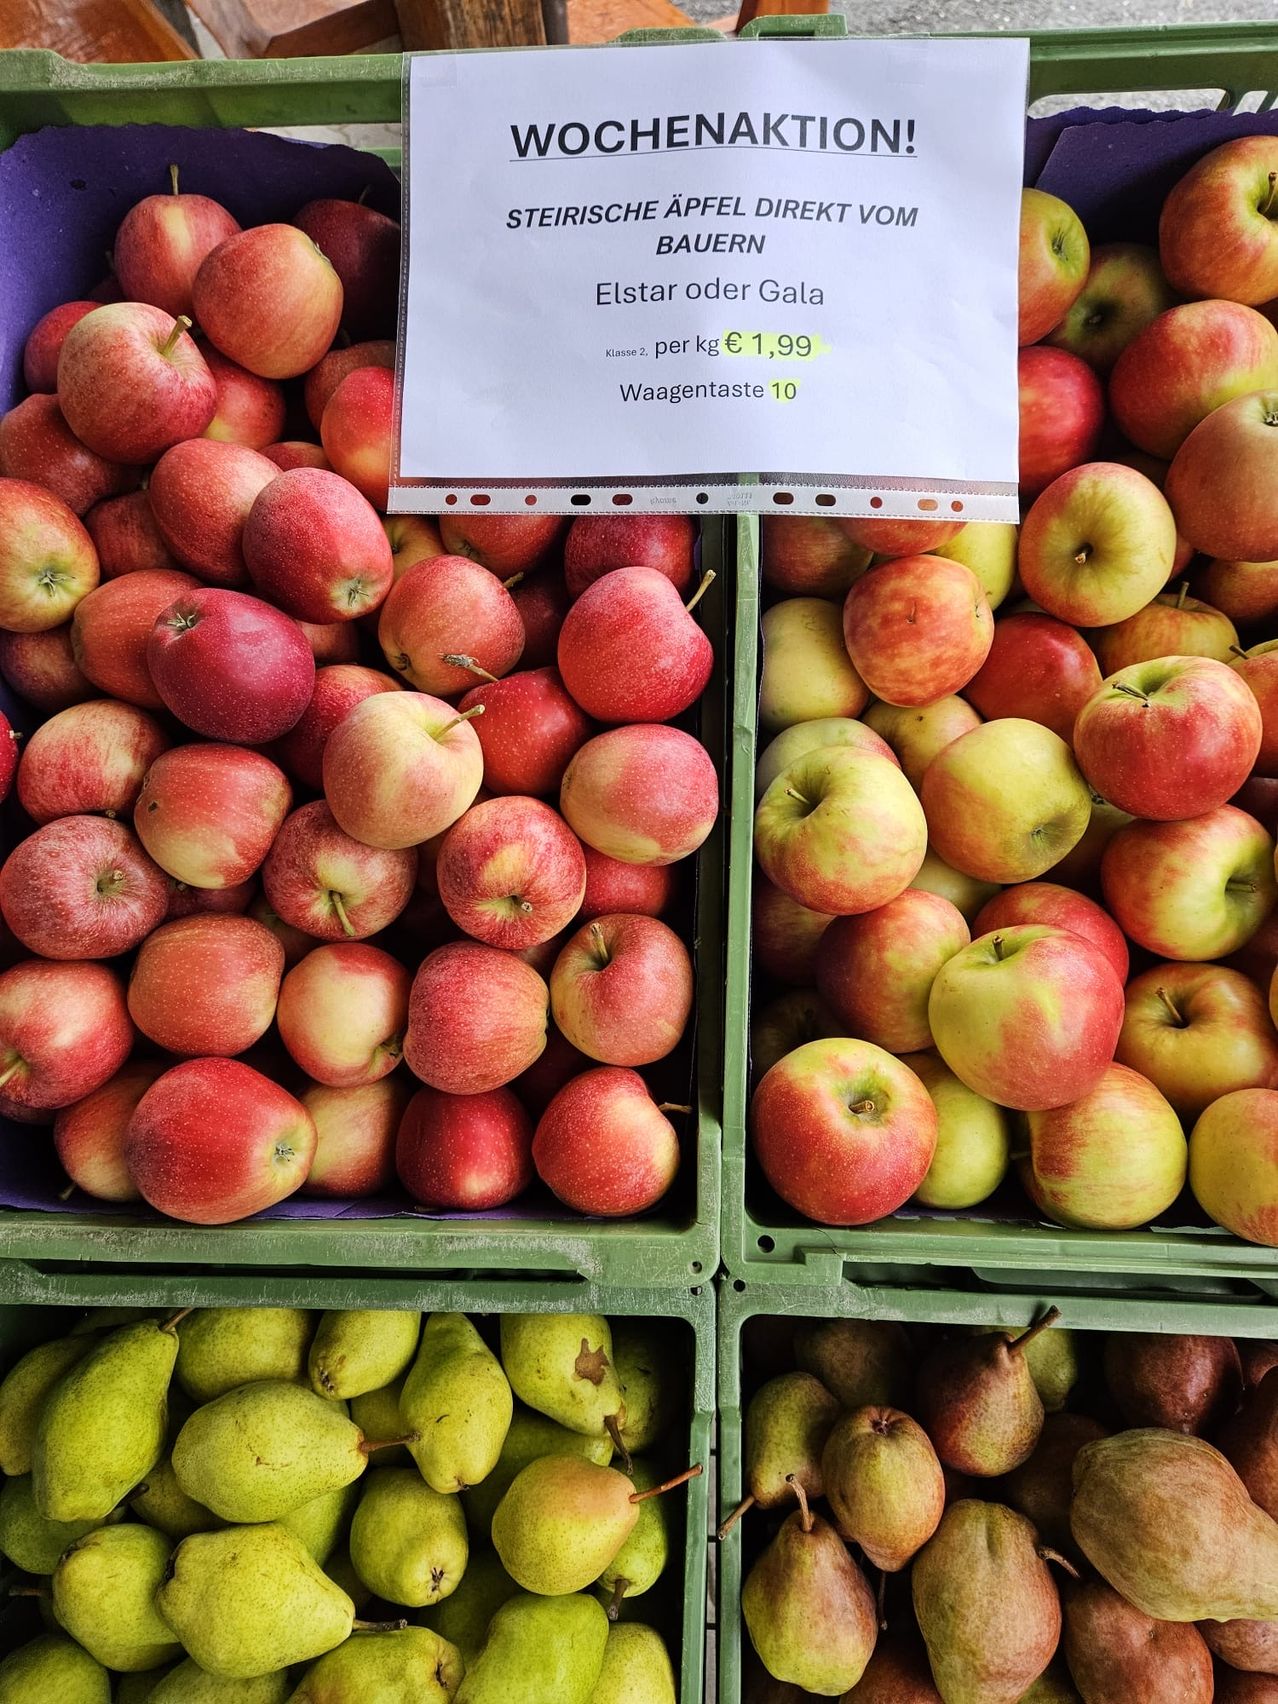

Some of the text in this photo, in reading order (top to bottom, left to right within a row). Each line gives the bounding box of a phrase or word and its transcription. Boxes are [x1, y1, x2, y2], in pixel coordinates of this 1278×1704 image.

[510, 112, 918, 162] WOCHENAKTION!
[506, 193, 919, 230] STEIRISCHE ÄPFEL DIREKT VOM
[655, 233, 767, 256] BAUERN
[596, 276, 825, 306] Elstar oder Gala
[605, 348, 637, 358] Klasse
[654, 338, 691, 360] per
[695, 334, 720, 357] kg
[724, 331, 743, 355] €
[751, 332, 813, 359] 1,99
[619, 382, 798, 404] Waagentaste 10
